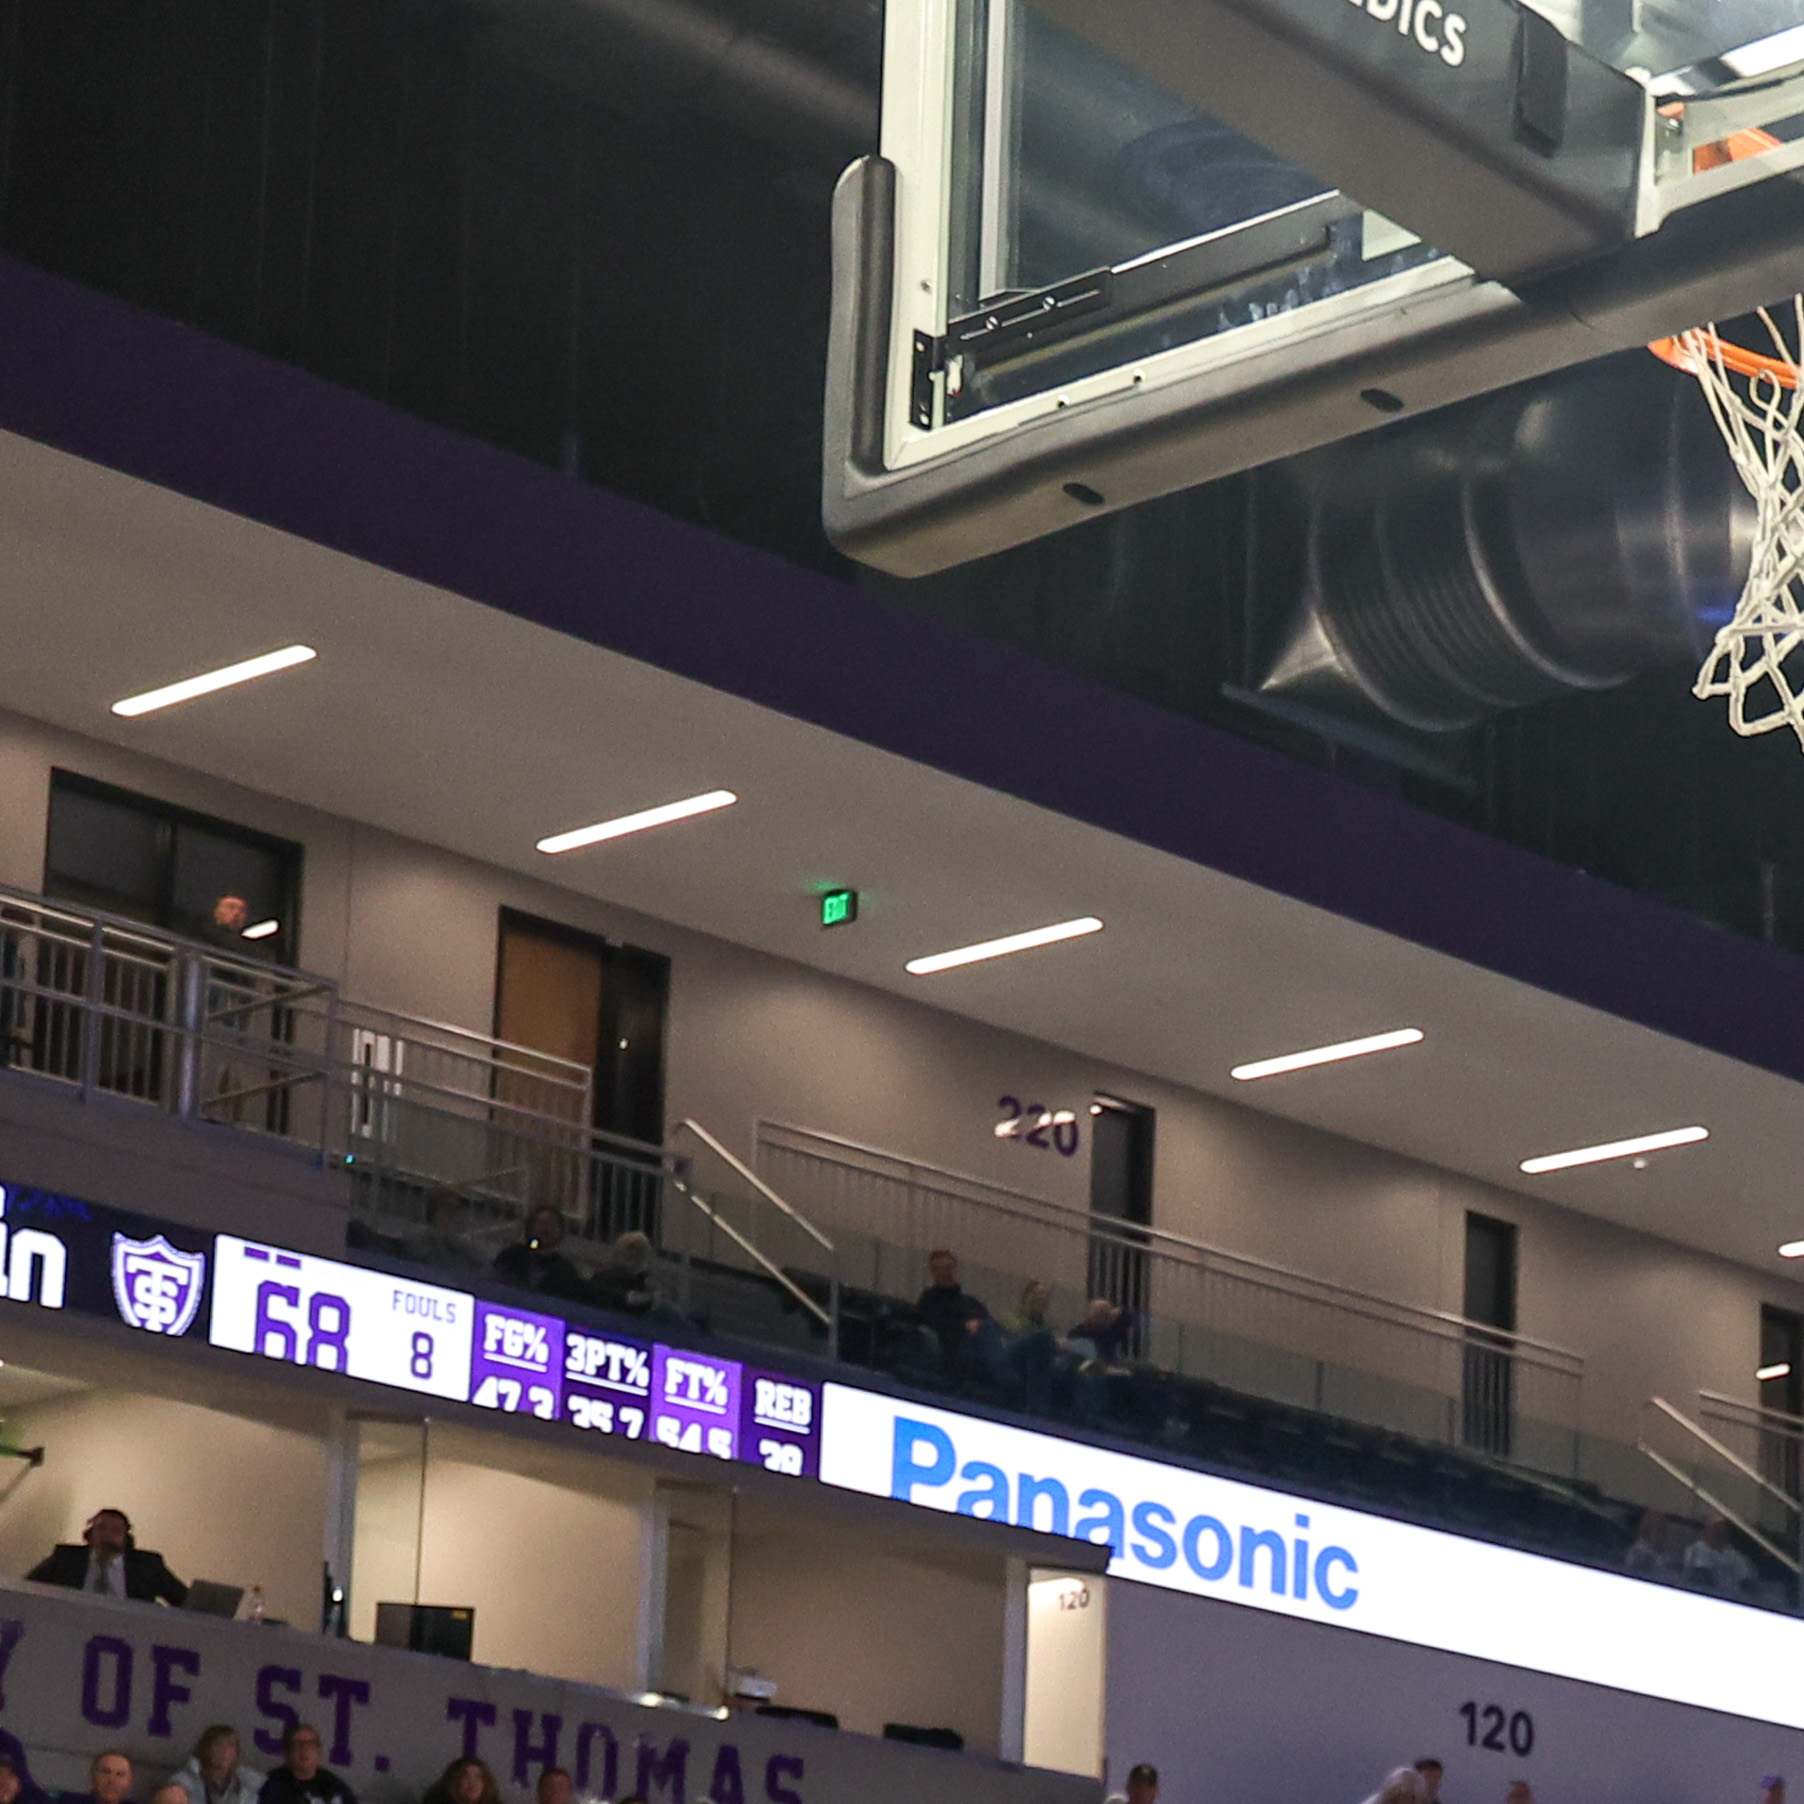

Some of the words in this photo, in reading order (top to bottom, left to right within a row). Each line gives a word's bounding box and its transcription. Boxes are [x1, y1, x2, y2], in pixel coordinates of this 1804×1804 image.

[995, 1095, 1080, 1157] 220
[253, 1279, 351, 1374] 68
[391, 1289, 457, 1324] FOULS
[410, 1331, 434, 1380] 8
[484, 1313, 549, 1364] FG%
[565, 1332, 650, 1389] 3PT%
[664, 1356, 728, 1407] FT%
[754, 1378, 813, 1427] REB
[891, 1413, 1360, 1612] Panasonic
[1058, 1589, 1090, 1611] 120
[82, 1635, 200, 1739] OF
[254, 1664, 390, 1773] ST.
[1459, 1700, 1535, 1758] 120
